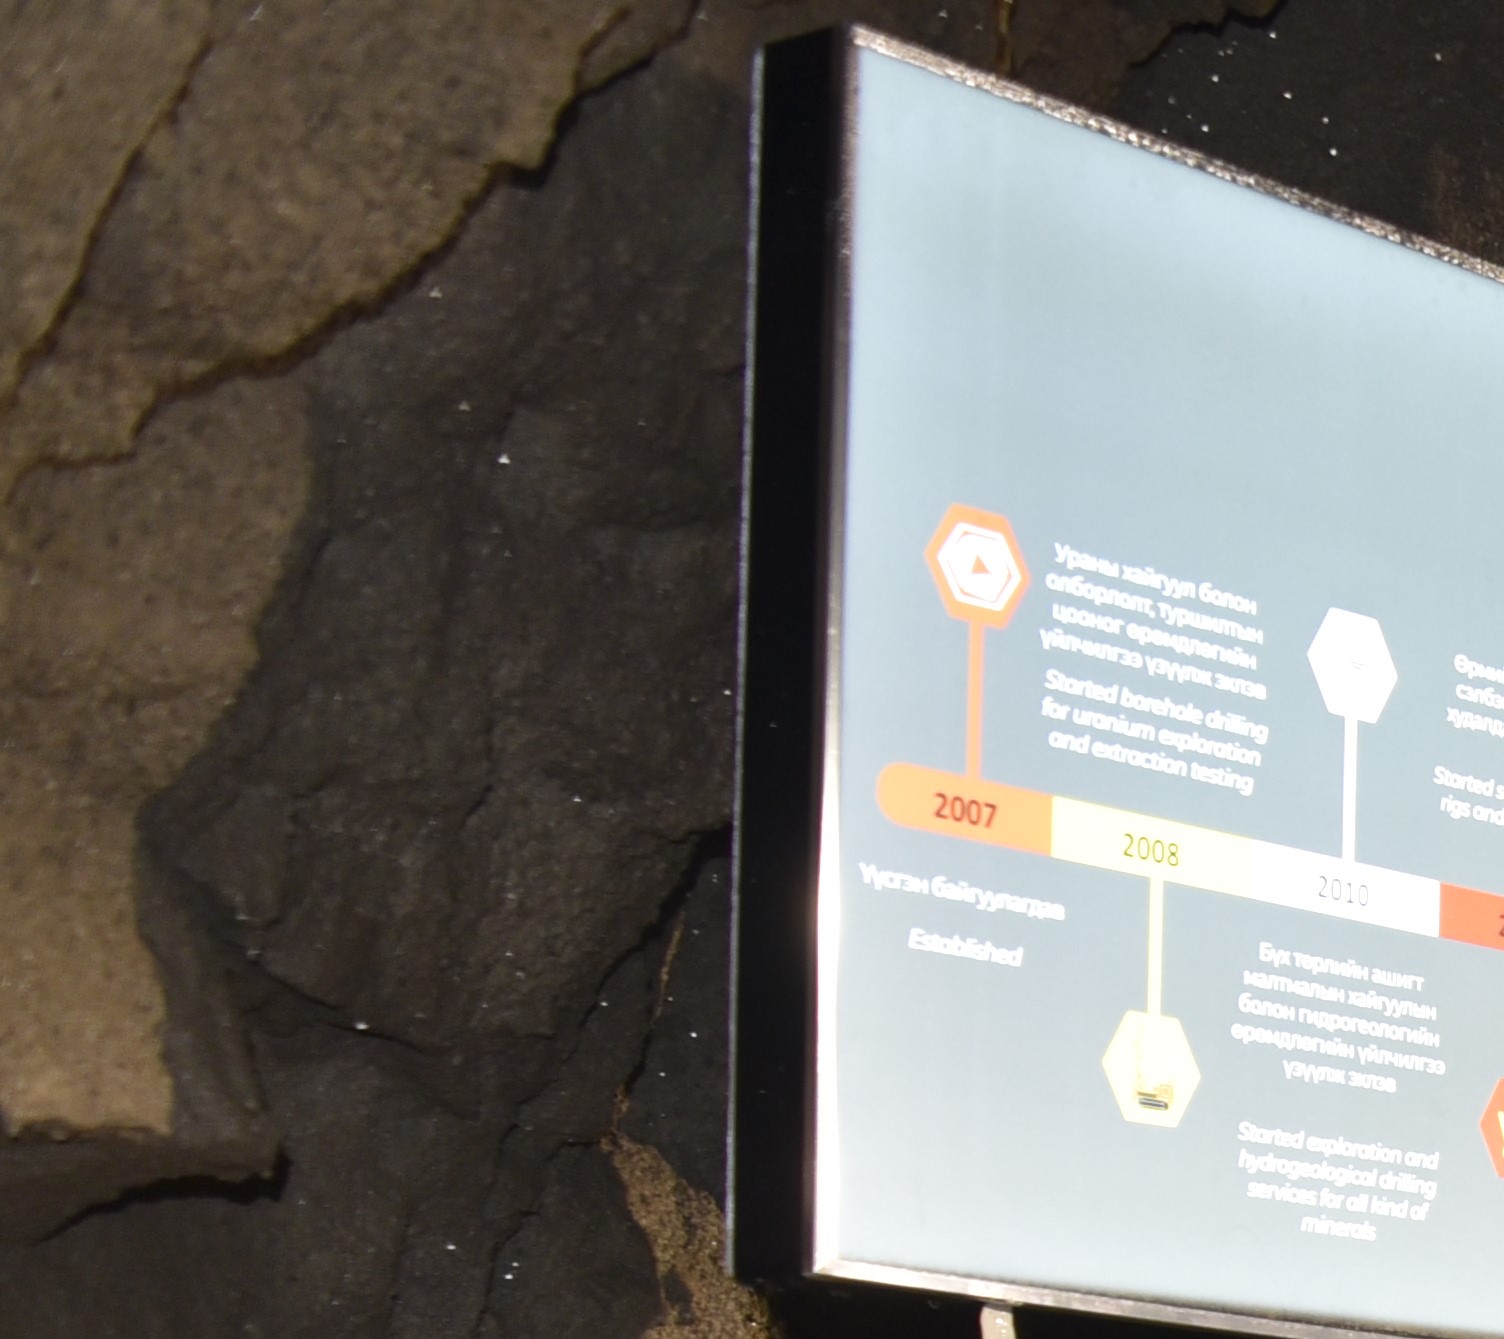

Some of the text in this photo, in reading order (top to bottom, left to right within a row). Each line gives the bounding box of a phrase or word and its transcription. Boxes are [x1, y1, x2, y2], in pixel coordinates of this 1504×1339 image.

[1044, 669, 1269, 745] Started borehole drilling
[1042, 696, 1261, 767] for uranium exploration
[1048, 731, 1254, 796] and extraction testing
[1433, 765, 1495, 797] Started
[934, 793, 998, 830] 2007
[1440, 794, 1471, 819] rigs
[1123, 832, 1180, 868] 2008
[1317, 875, 1369, 907] 2010
[908, 927, 1024, 967] Established
[1237, 1121, 1440, 1170] Started exploration and
[1238, 1148, 1438, 1201] hydrogeological drilling
[1246, 1181, 1430, 1221] services for all kind of
[1300, 1216, 1377, 1241] minerals
